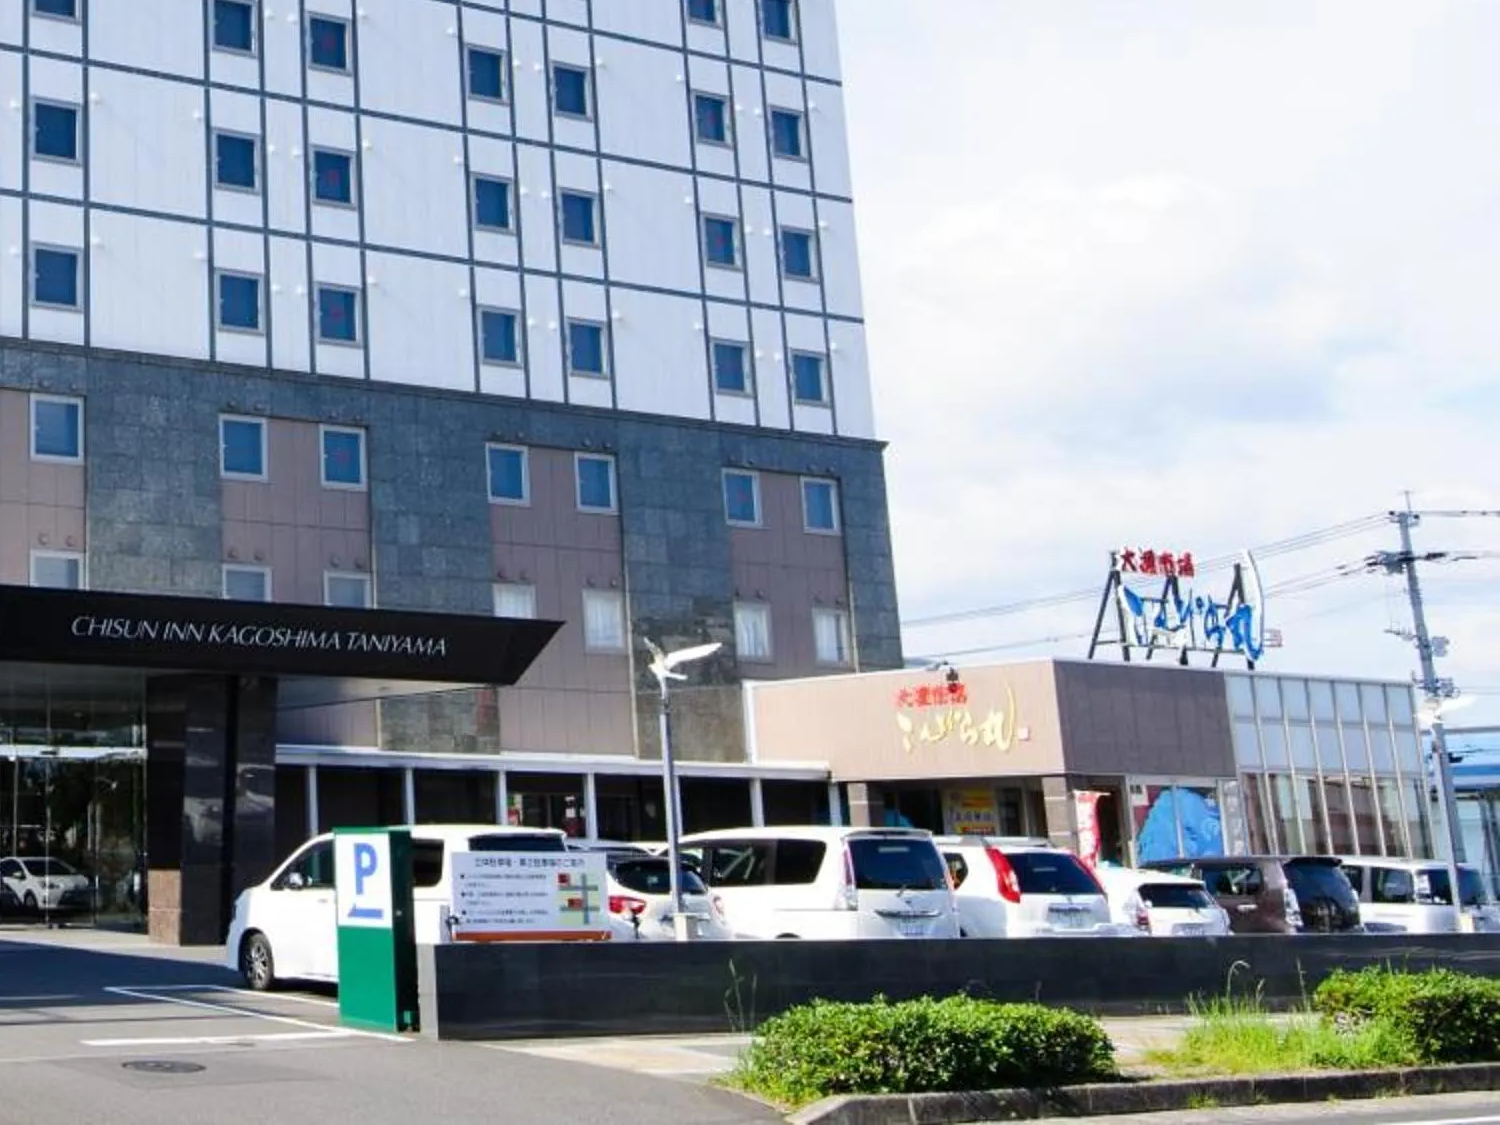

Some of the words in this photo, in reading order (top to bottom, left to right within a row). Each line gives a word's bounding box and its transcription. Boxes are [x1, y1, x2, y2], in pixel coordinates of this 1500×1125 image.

[70, 615, 159, 641] CHISUN
[162, 618, 205, 644] INN
[207, 623, 341, 651] KAGOSHIMA
[345, 631, 447, 658] TANIYAMA
[353, 842, 379, 896] P
